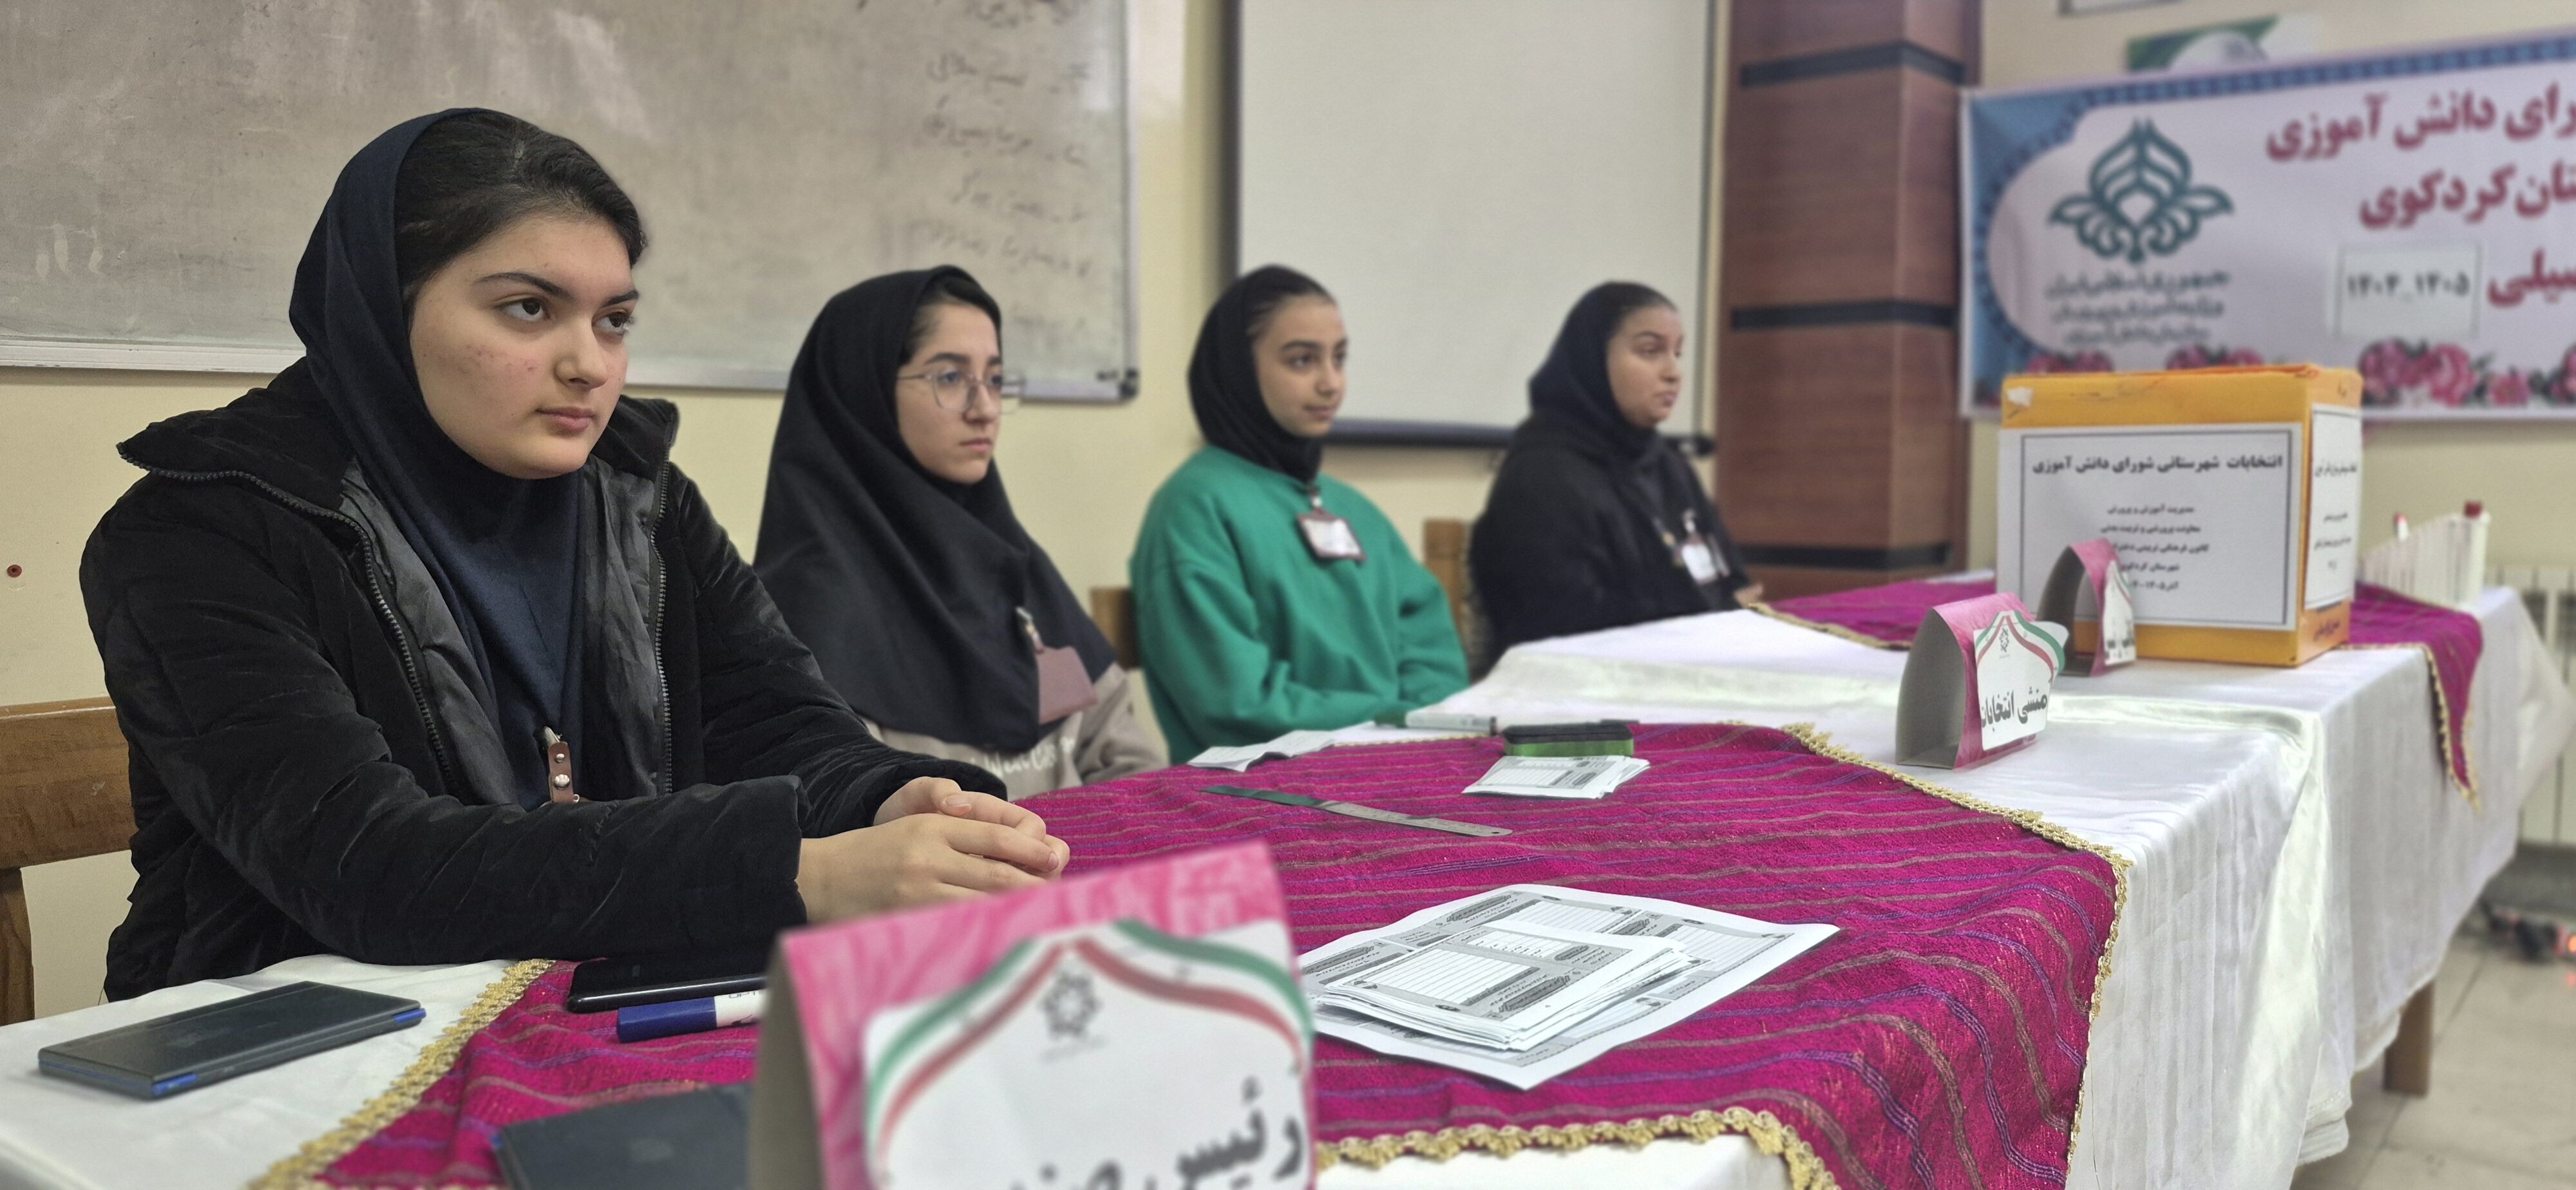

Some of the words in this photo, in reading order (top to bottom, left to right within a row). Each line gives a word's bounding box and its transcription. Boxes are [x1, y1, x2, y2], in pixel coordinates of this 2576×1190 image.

[2265, 92, 2389, 162] آموزی
[2393, 90, 2496, 150] دانش
[2358, 163, 2517, 229] کردکوی
[2515, 161, 2576, 218] تان
[2487, 247, 2576, 308] یلی
[2032, 455, 2072, 474] آموزی
[2075, 457, 2109, 473] دانش
[2112, 456, 2154, 473] شورای
[2157, 455, 2220, 473] شهرستانی
[2226, 455, 2282, 471] انتخابات
[2017, 686, 2048, 724] منشی
